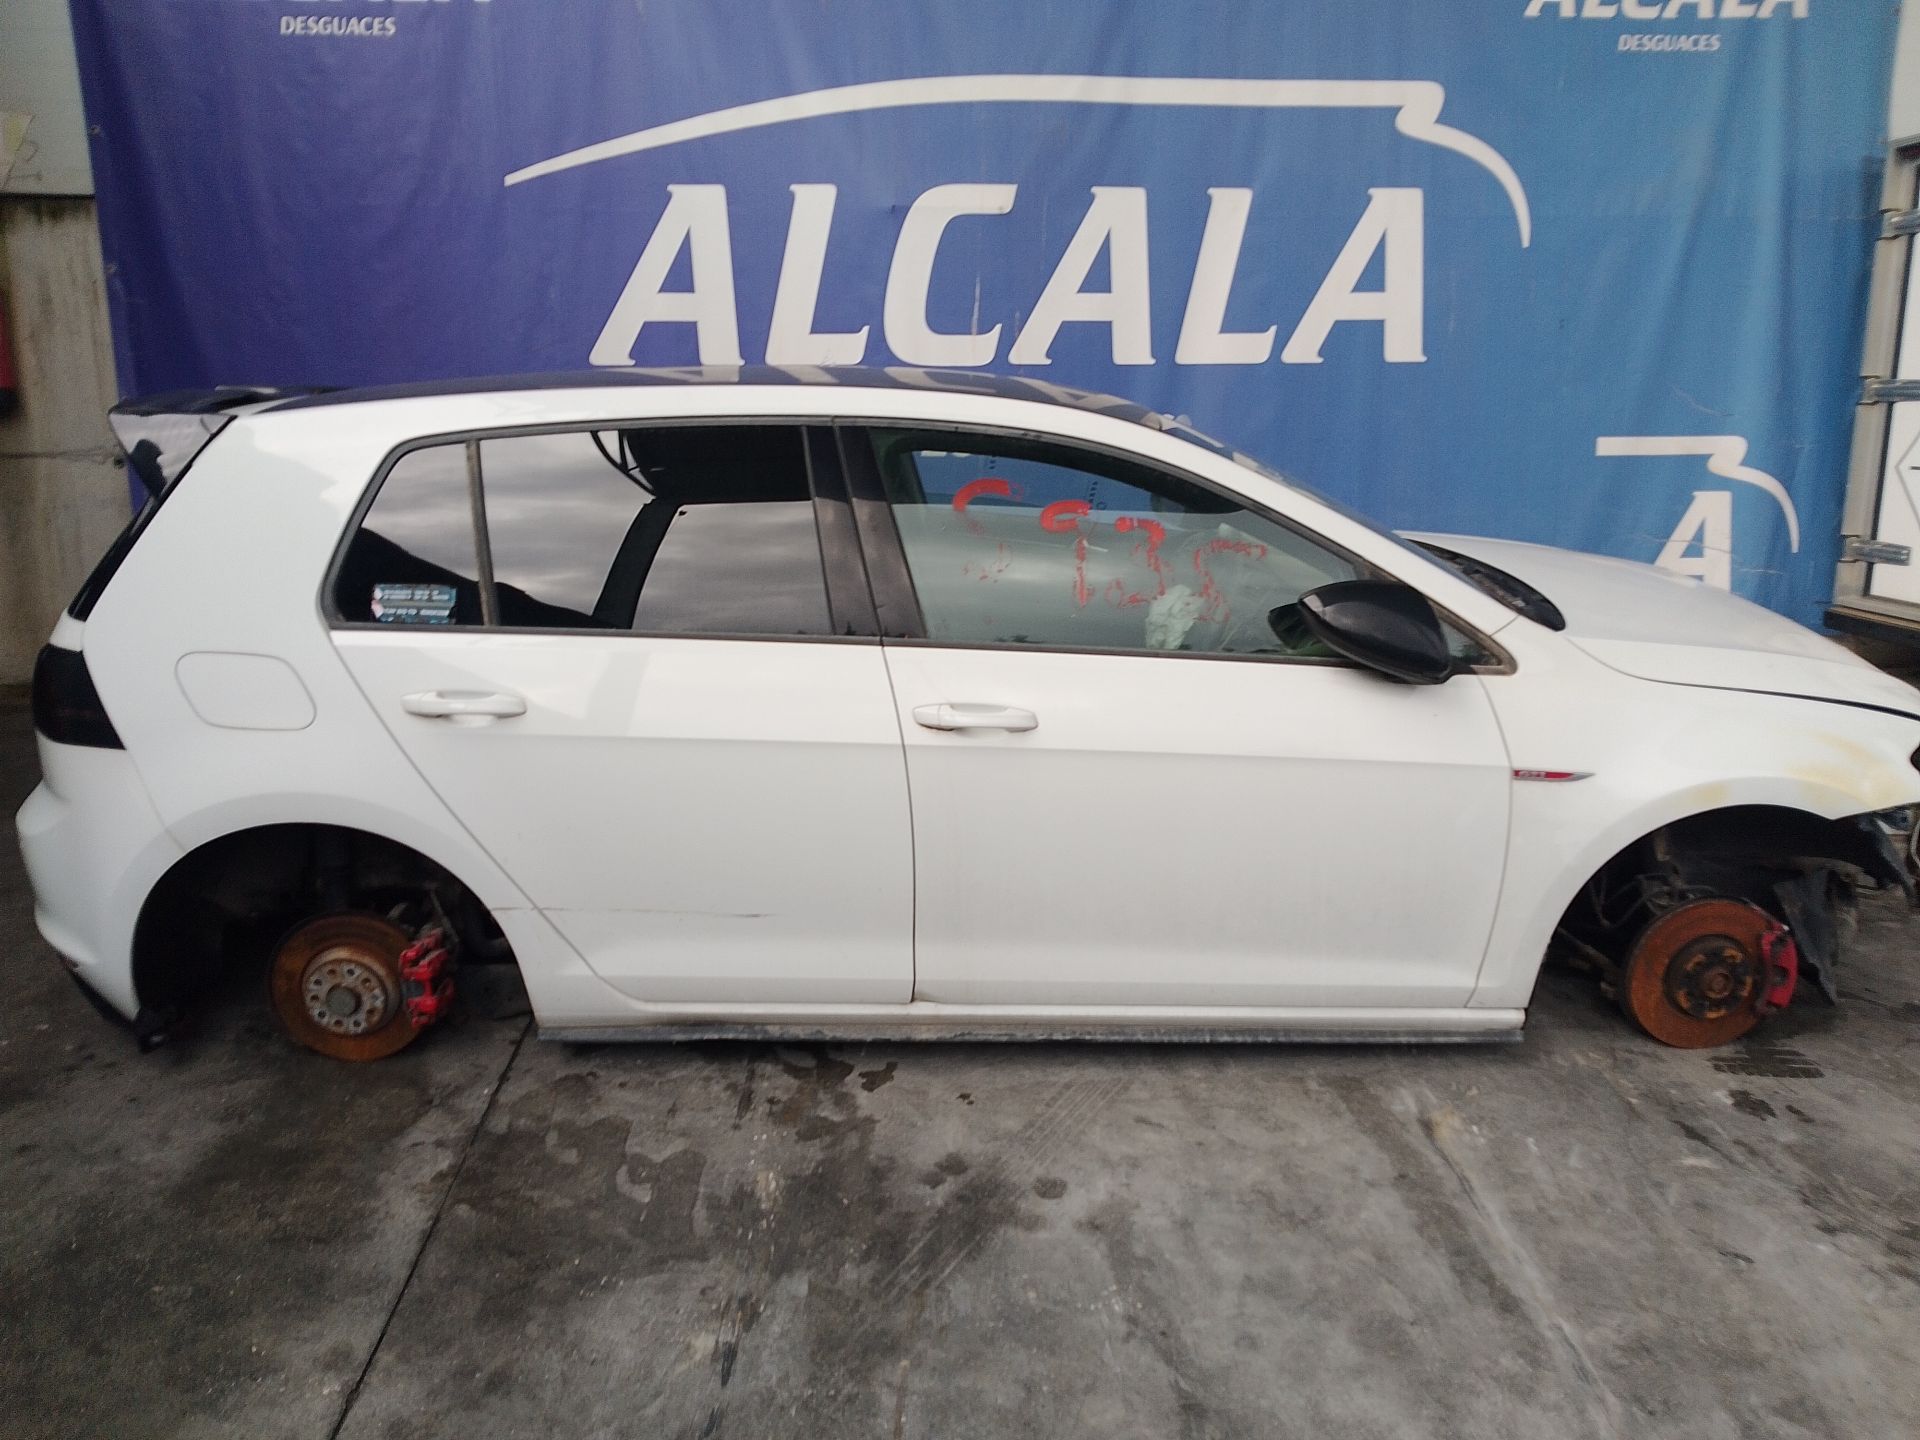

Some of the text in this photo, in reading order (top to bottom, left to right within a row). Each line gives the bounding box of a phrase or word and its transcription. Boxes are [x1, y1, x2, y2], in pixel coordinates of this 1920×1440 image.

[280, 15, 396, 36] DESGUACES
[1617, 33, 1722, 51] DESGUACES
[588, 182, 1428, 367] ALCALA
